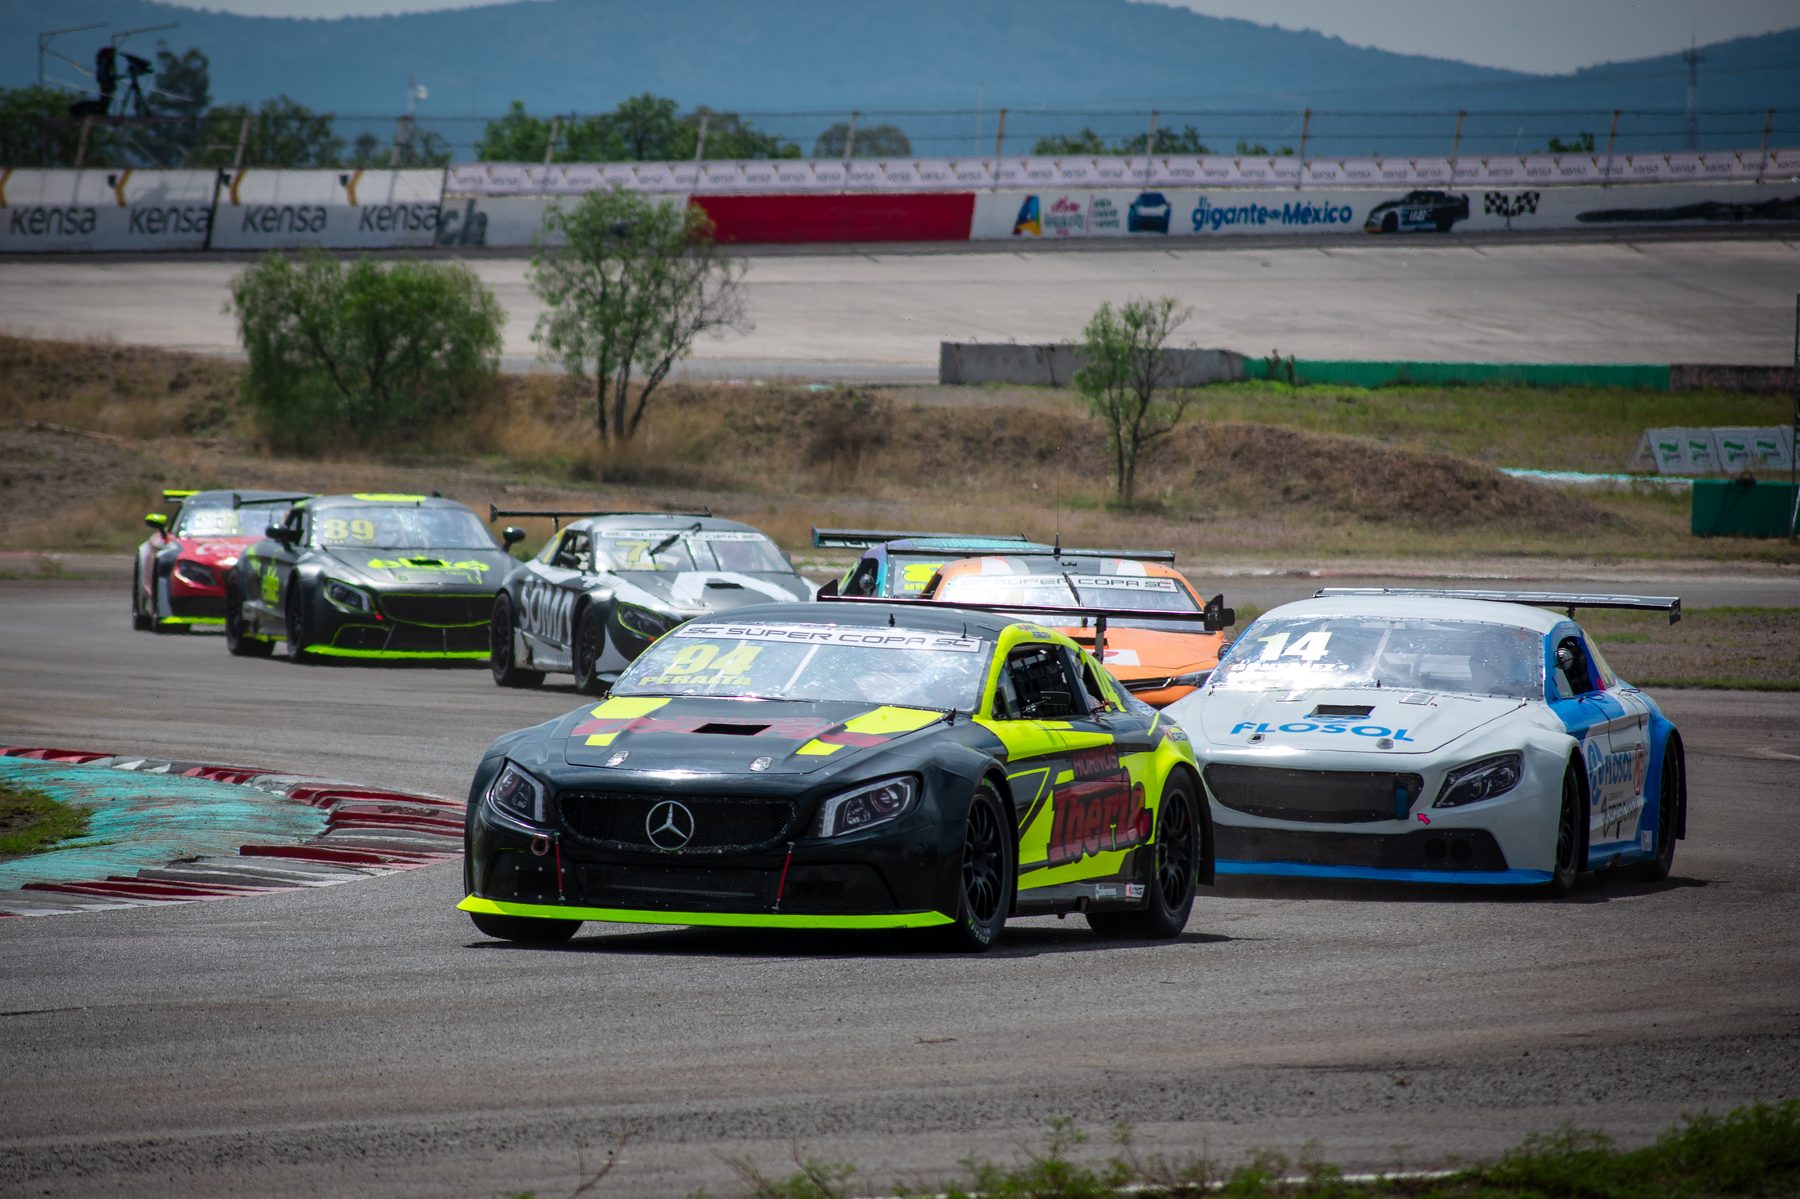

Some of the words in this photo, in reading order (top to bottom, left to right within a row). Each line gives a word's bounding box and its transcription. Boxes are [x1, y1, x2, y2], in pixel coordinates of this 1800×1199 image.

[10, 205, 97, 235] kensa
[129, 205, 212, 234] kensa
[241, 204, 328, 233] kensa
[358, 204, 440, 232] kensa
[1191, 203, 1267, 231] gigante
[1282, 201, 1353, 225] México
[323, 518, 376, 541] 89
[614, 540, 652, 563] 7
[1078, 578, 1140, 588] COPA
[1145, 580, 1173, 590] SC
[519, 575, 575, 646] SOMA
[686, 626, 718, 636] SC
[721, 627, 834, 642] SUPER
[838, 633, 927, 648] COPA
[931, 637, 976, 650] SC
[1257, 631, 1333, 661] 14
[664, 643, 764, 676] 94
[1230, 721, 1415, 743] FLOSOL
